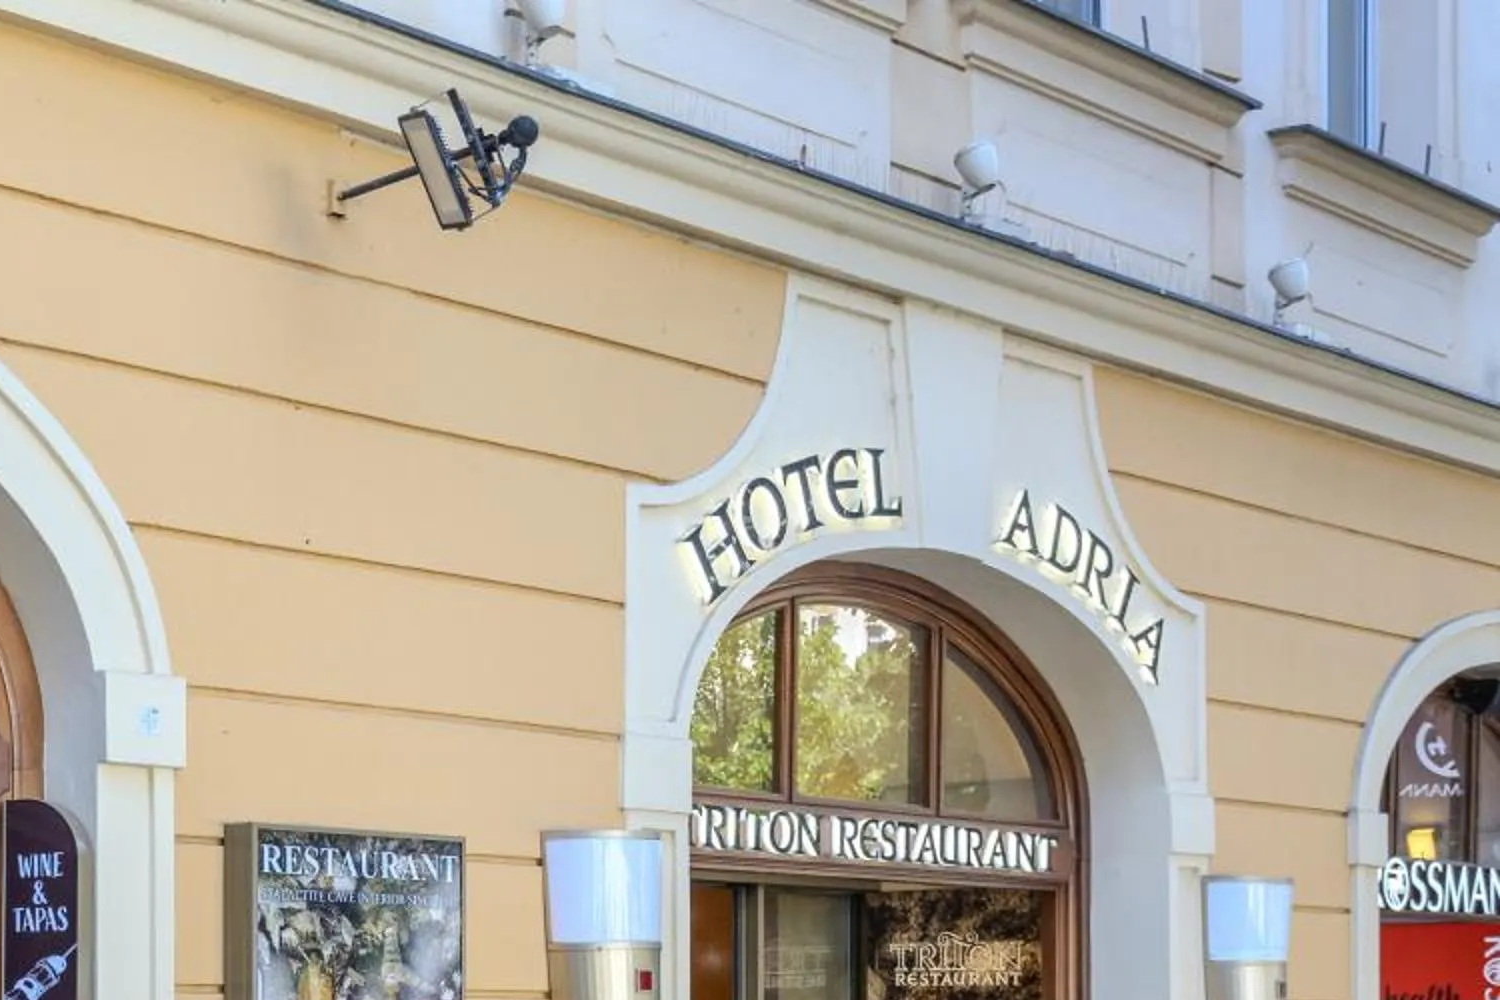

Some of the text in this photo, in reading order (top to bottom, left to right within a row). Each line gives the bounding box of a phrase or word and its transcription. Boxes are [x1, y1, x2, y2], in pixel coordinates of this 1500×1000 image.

[680, 447, 1166, 686] HOTEL ADRIA
[832, 816, 1059, 874] RESTAURANT
[17, 851, 65, 879] WINE
[260, 843, 459, 883] RESTAURANT
[32, 880, 48, 905] &
[12, 905, 69, 933] TAPAS
[888, 931, 1025, 972] TRITON
[894, 971, 1023, 987] RESTAURANT
